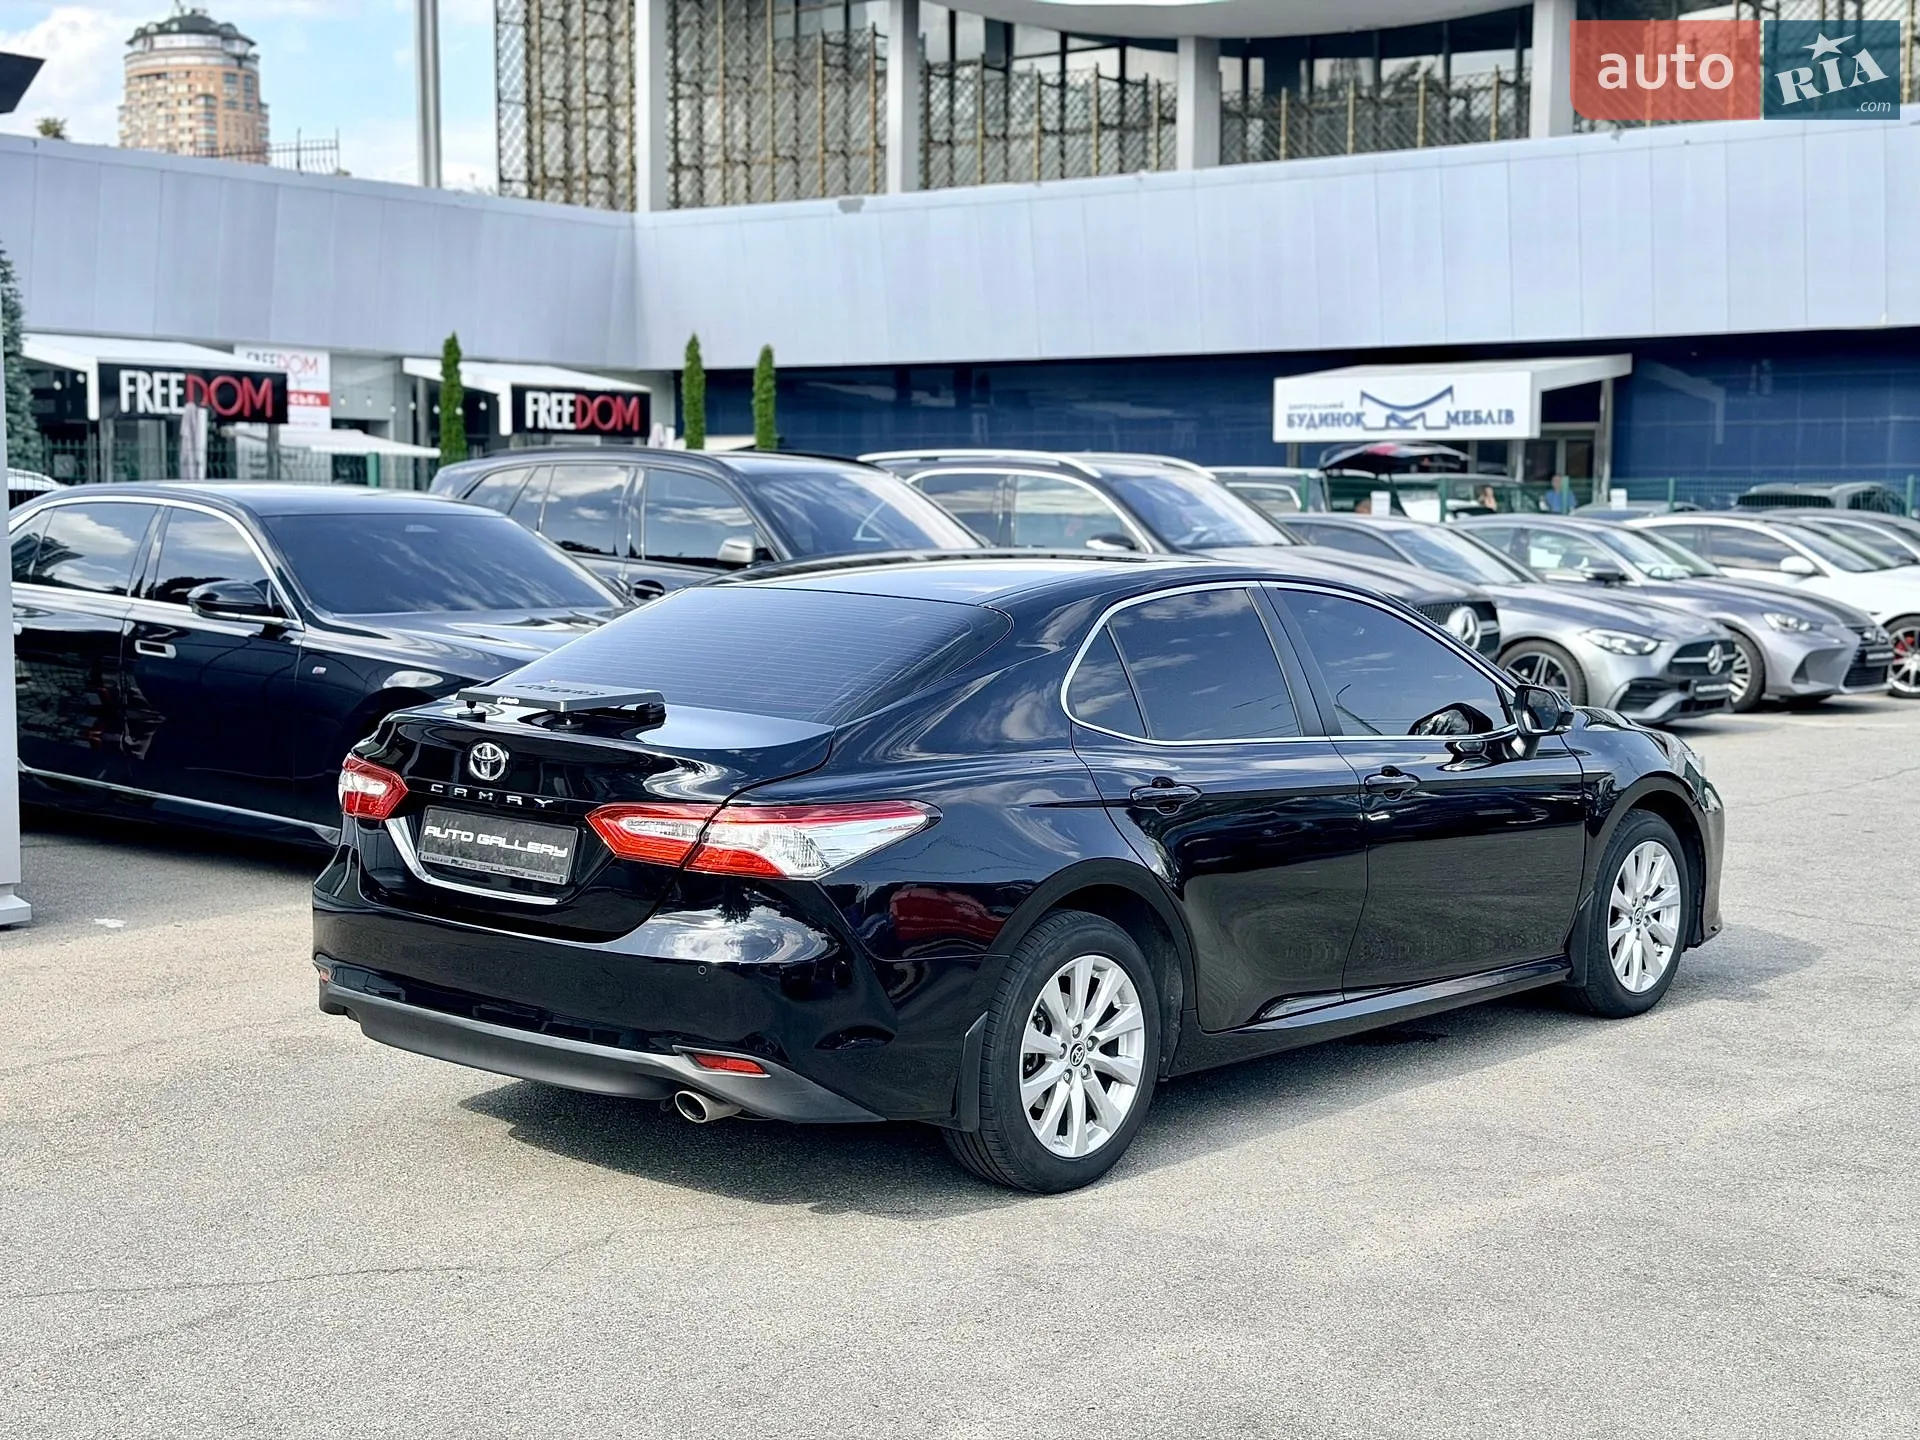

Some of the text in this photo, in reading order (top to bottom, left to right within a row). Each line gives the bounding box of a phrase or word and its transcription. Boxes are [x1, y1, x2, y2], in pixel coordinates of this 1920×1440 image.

[119, 369, 273, 418] FREEDOM
[525, 391, 640, 432] FREEDOM
[1287, 408, 1516, 430] БУДИНОК МЕБЛІВ
[430, 784, 553, 808] CAMRY
[424, 825, 569, 858] AUTO GALLERY
